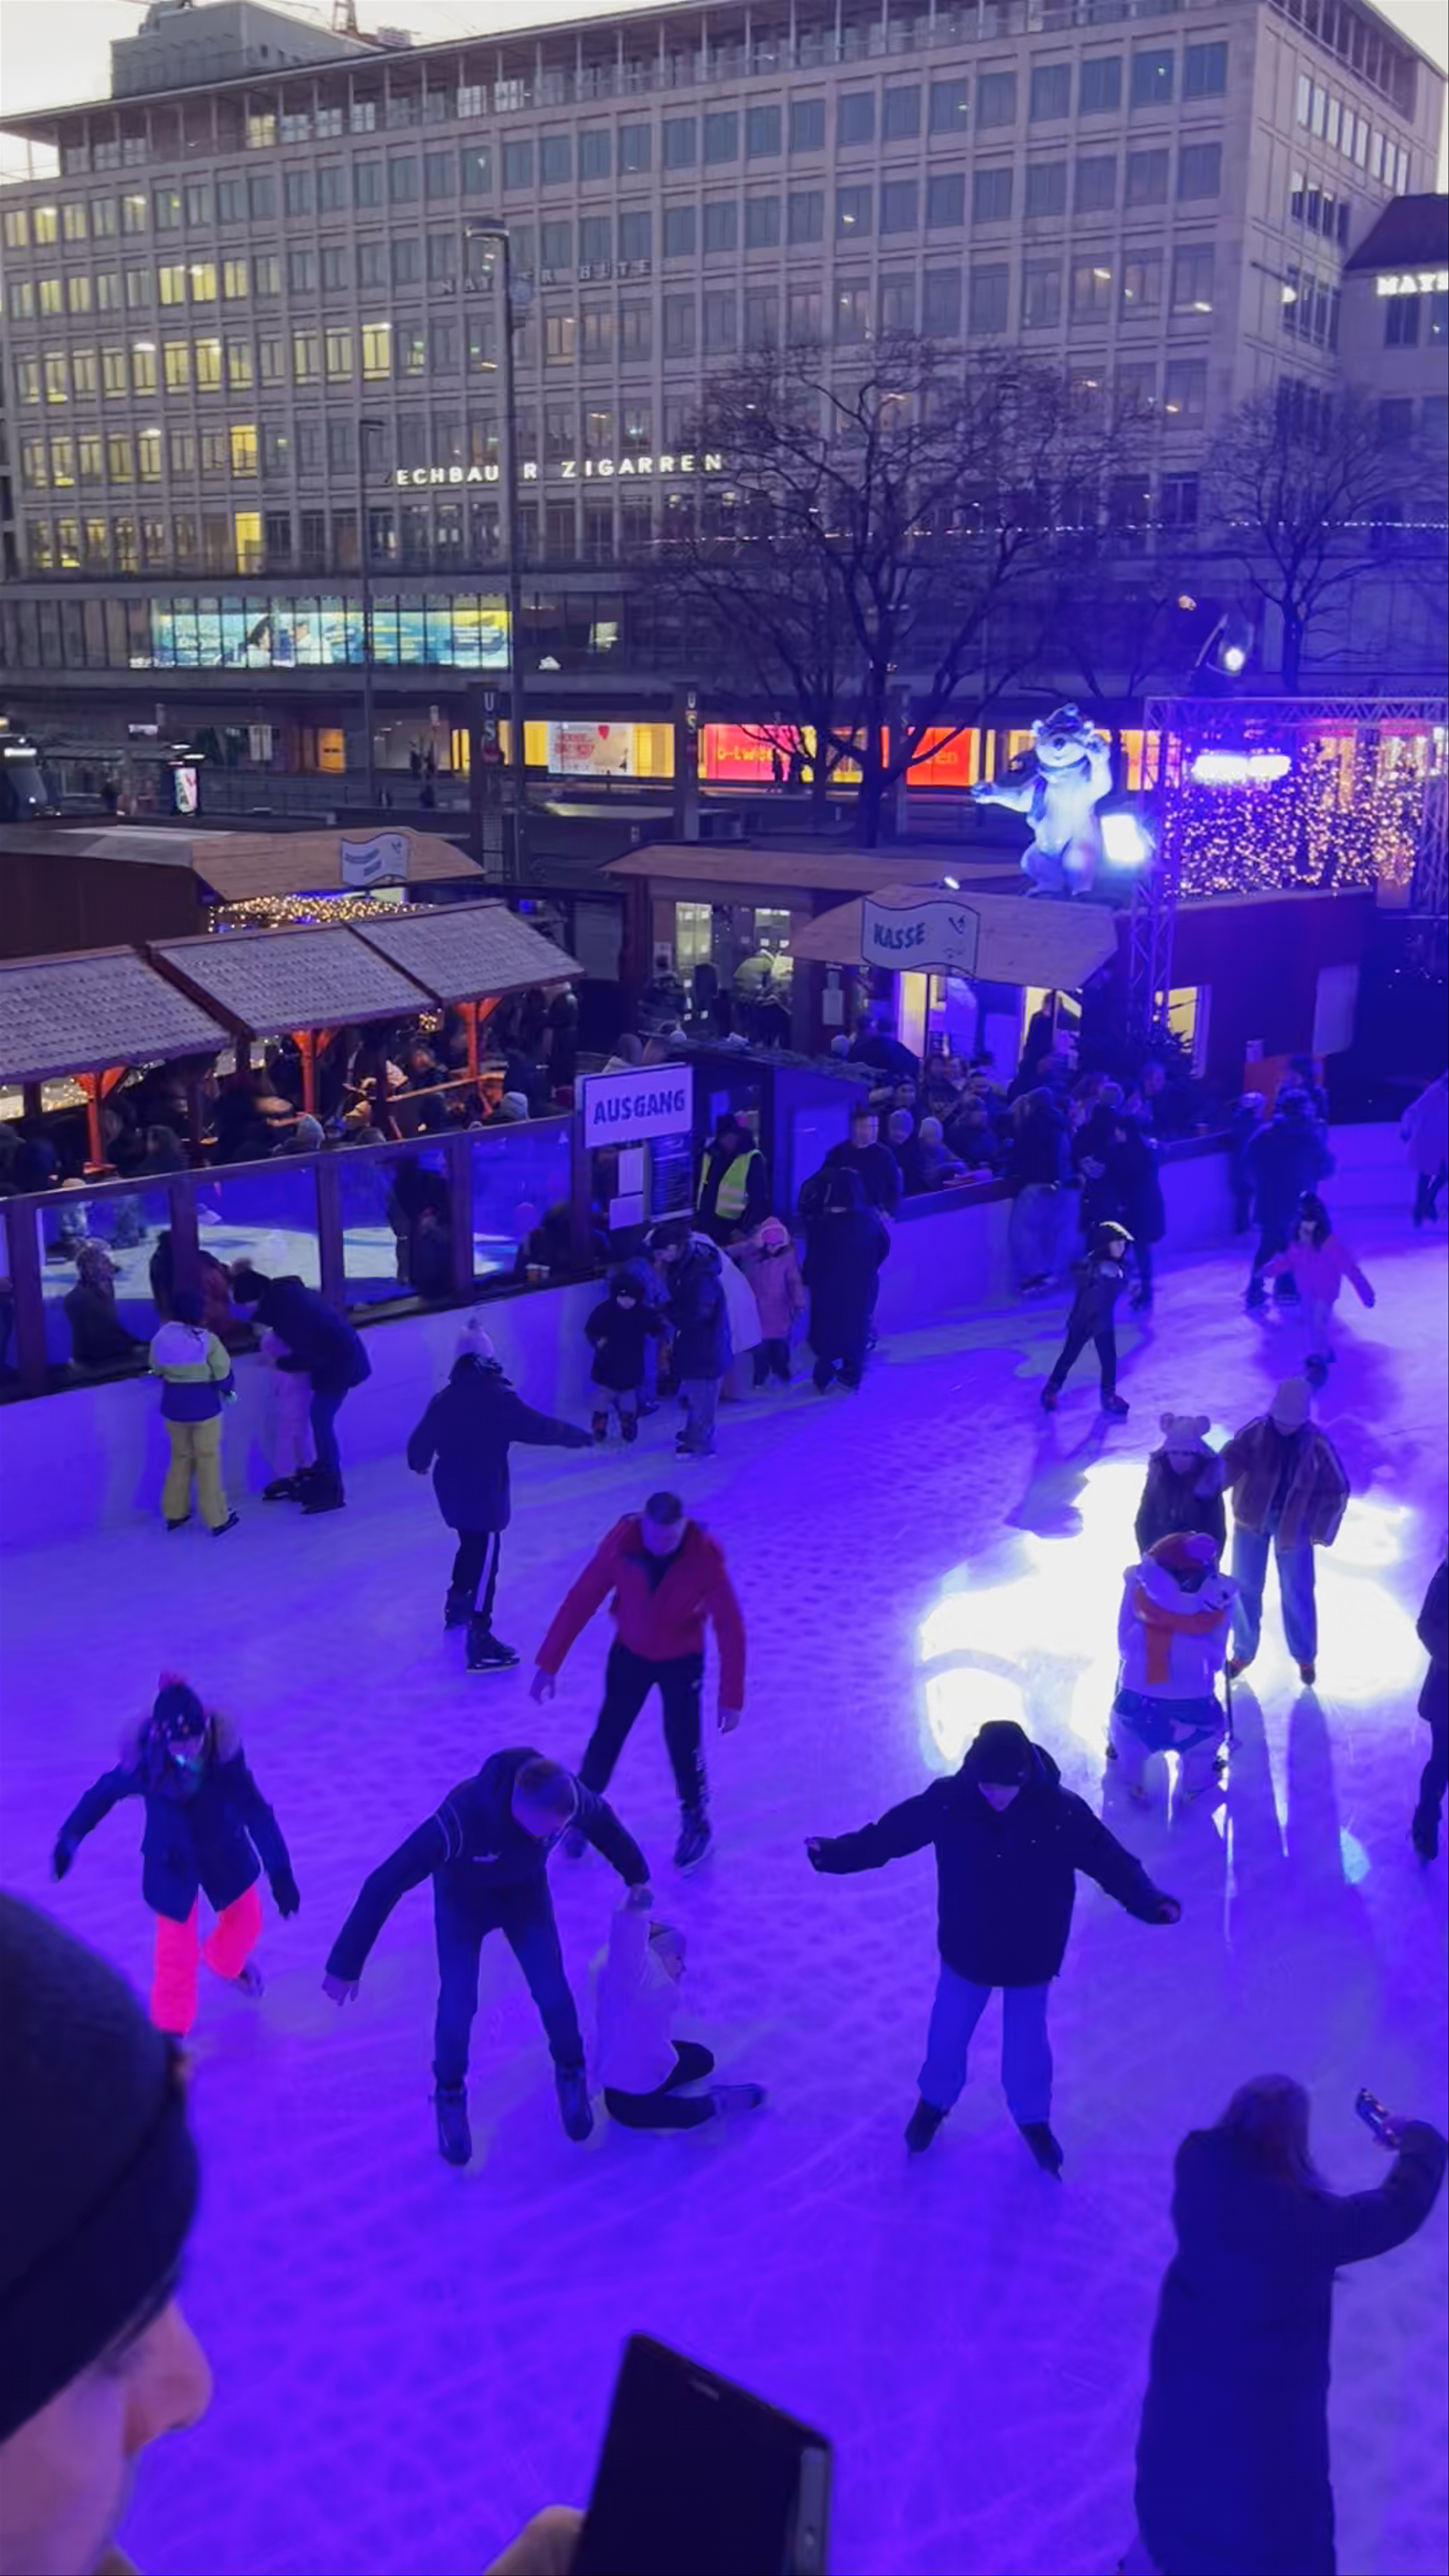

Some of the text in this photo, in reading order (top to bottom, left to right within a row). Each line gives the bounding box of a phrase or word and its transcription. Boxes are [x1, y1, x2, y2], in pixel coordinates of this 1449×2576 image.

[561, 454, 722, 477] ZIGARREN
[484, 692, 494, 711] U
[688, 691, 696, 708] U
[485, 720, 495, 740] S
[687, 715, 697, 734] S
[874, 922, 925, 949] KASSE
[594, 1089, 686, 1126] AUSGANG
